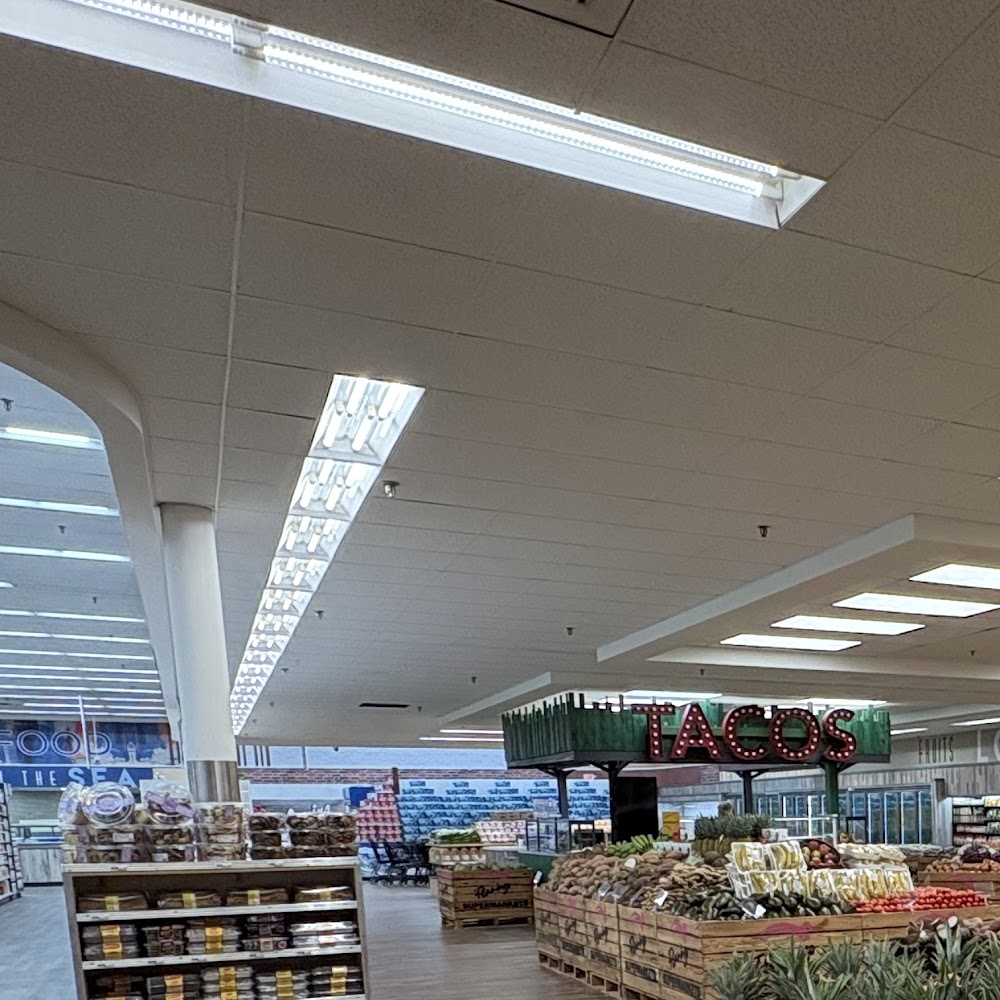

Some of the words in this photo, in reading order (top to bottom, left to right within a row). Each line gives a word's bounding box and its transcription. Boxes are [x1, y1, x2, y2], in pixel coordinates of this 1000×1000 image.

[631, 703, 857, 761] TACOS
[918, 736, 954, 764] FRUITS
[22, 770, 57, 786] THE
[68, 767, 138, 788] SEA
